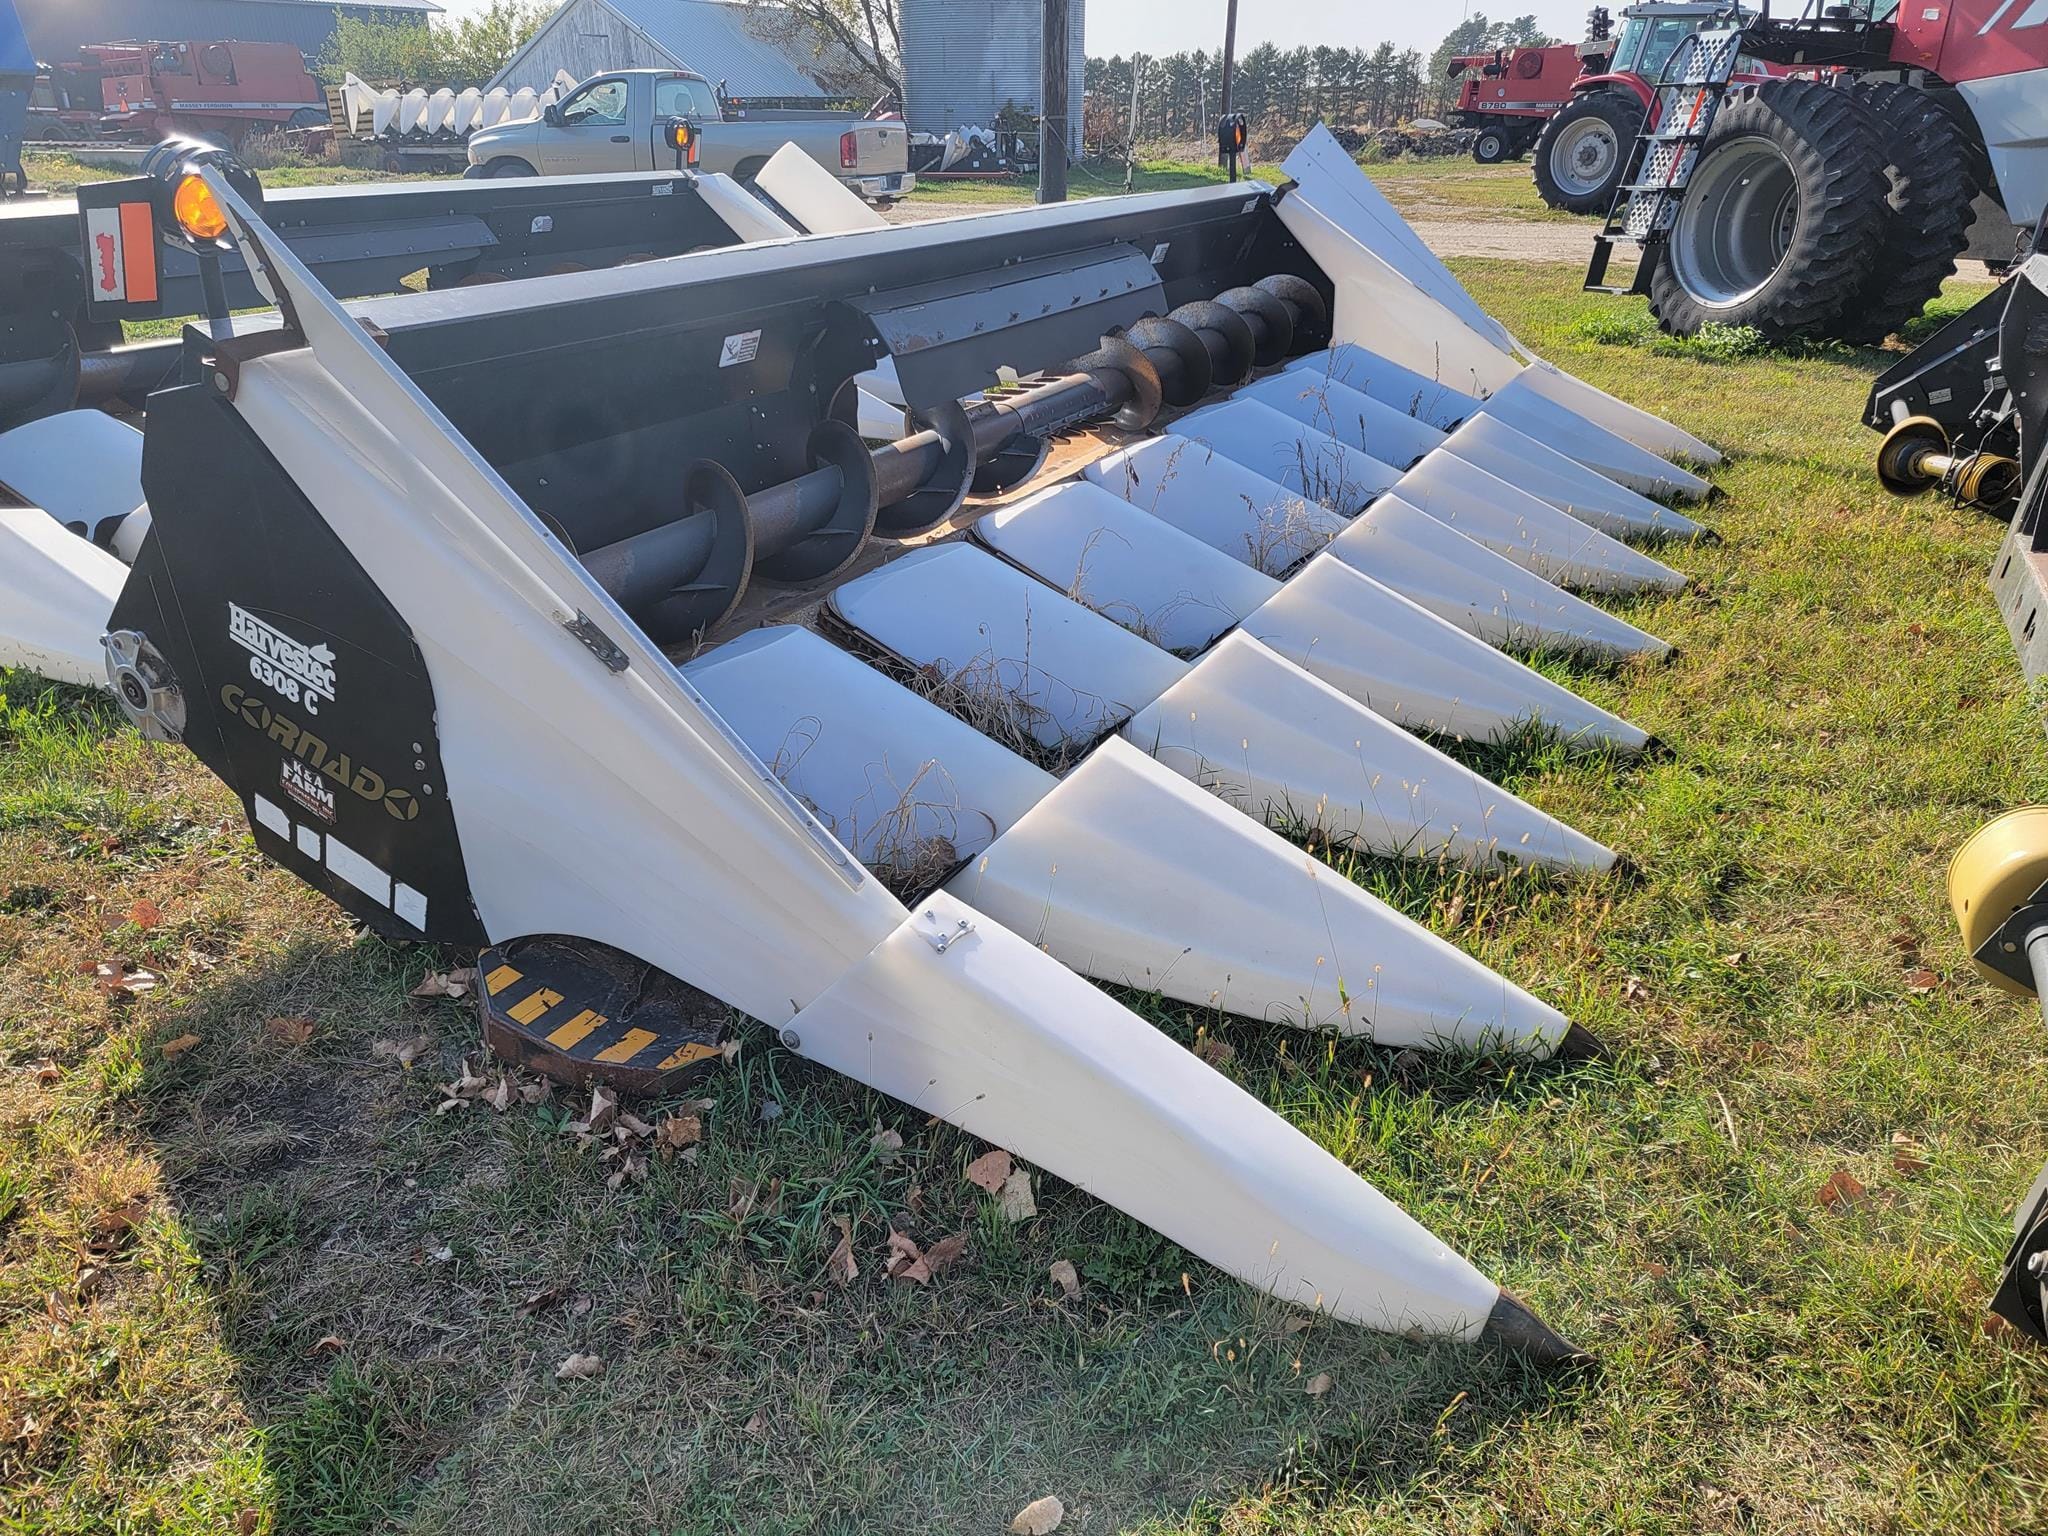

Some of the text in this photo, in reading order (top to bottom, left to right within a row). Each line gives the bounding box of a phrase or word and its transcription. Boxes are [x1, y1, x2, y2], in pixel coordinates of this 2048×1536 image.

[229, 602, 336, 694] Harvestec
[250, 656, 319, 715] 6308 C
[220, 684, 420, 821] CORNADO
[293, 760, 324, 789] K & A
[282, 762, 334, 809] FARM
